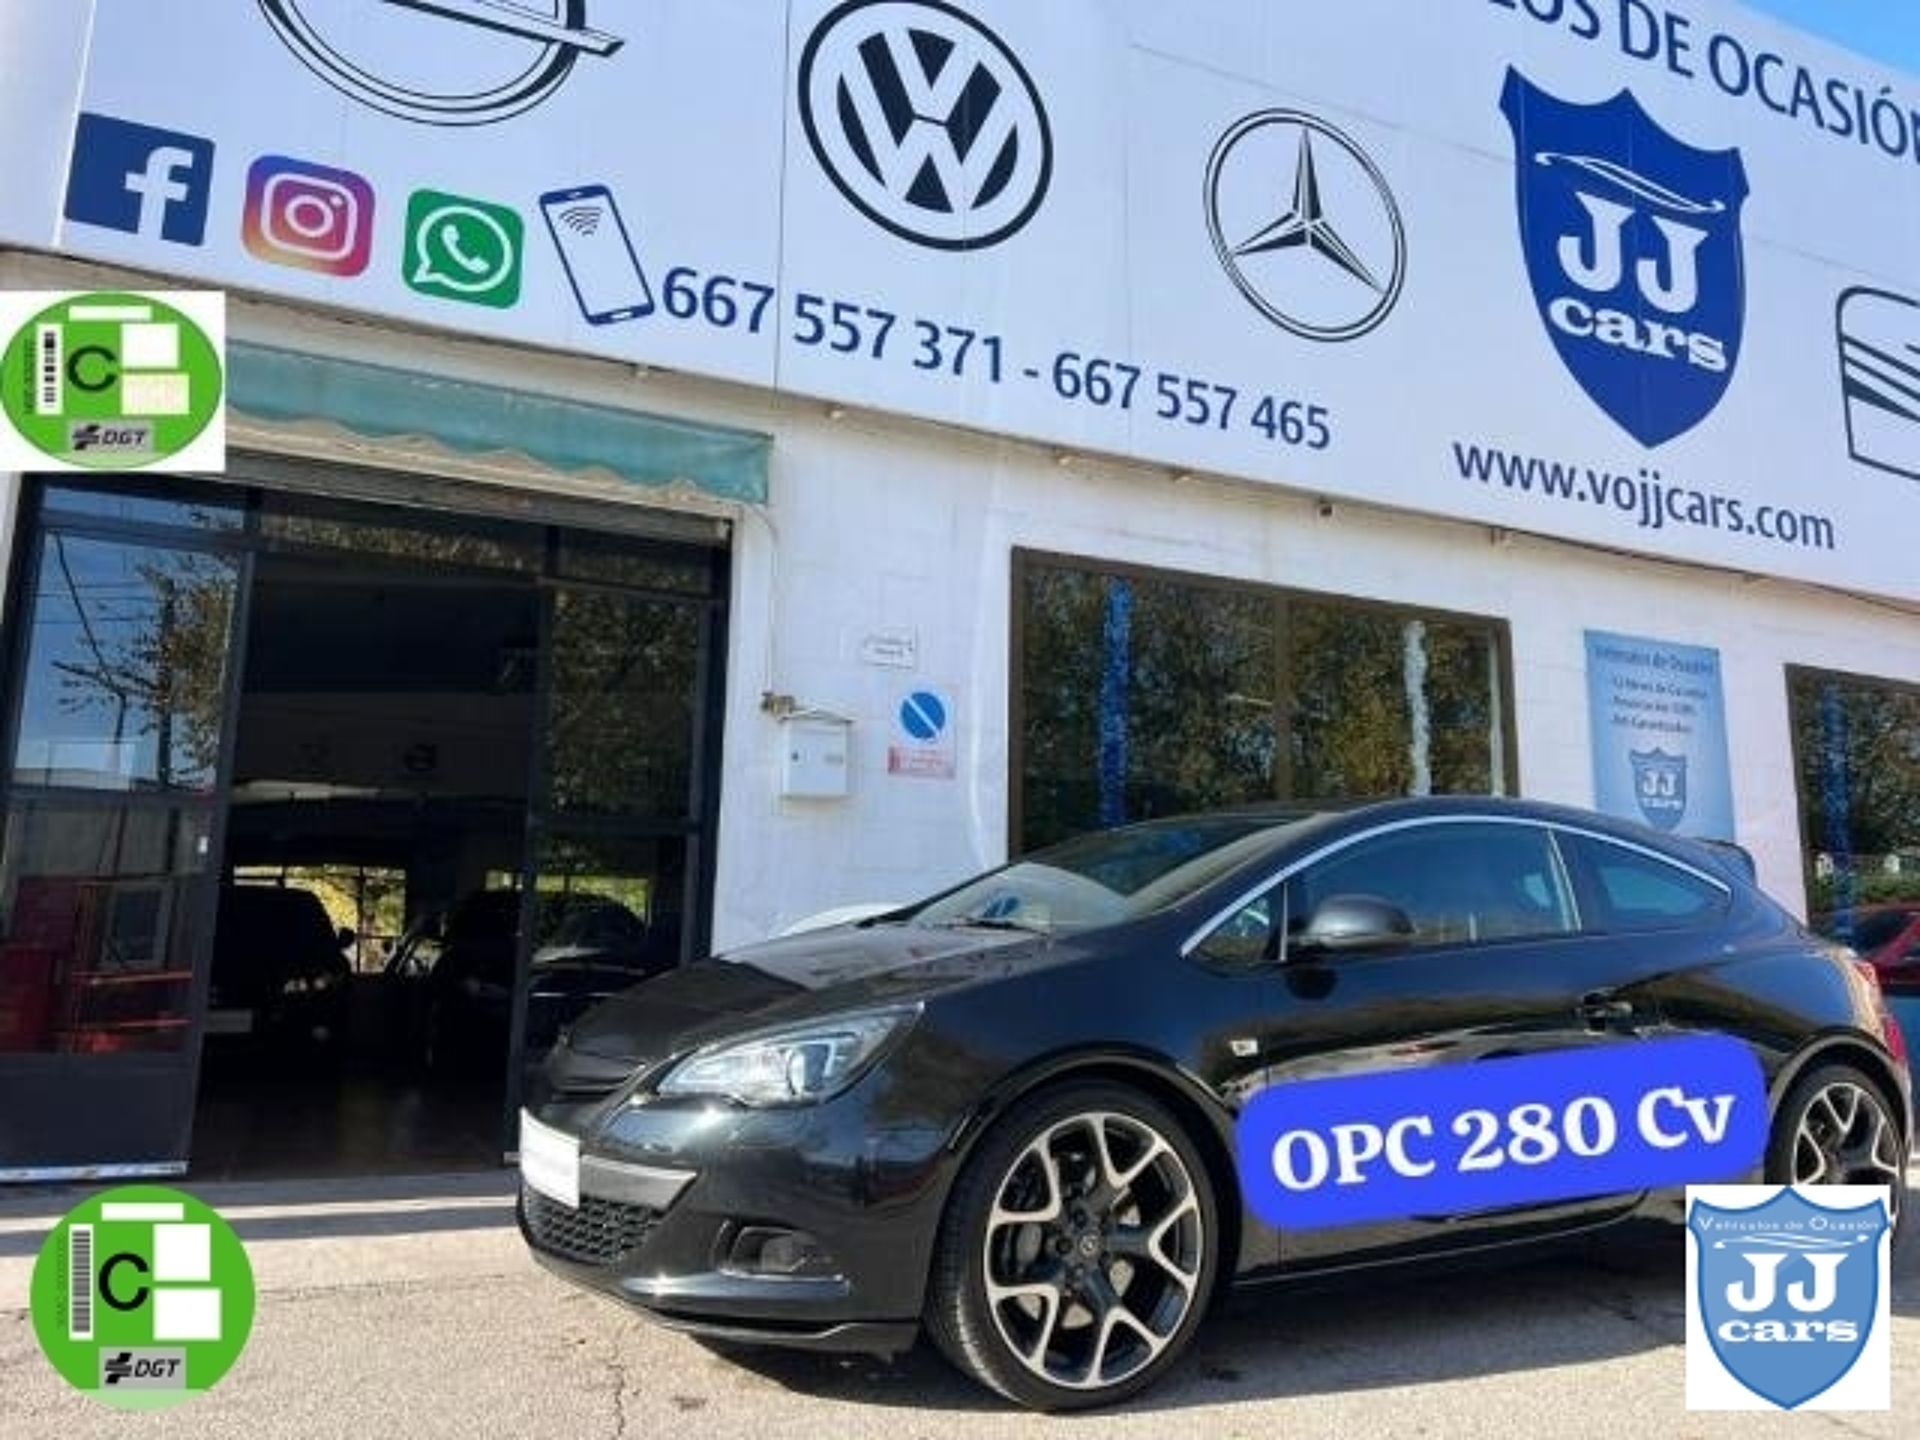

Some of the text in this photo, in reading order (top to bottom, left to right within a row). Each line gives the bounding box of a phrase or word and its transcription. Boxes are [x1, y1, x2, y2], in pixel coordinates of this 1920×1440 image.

[1620, 0, 1920, 165] DE OCASIÓ
[1557, 191, 1709, 313] JJ
[662, 266, 775, 333] 667
[792, 293, 897, 359] 557
[912, 318, 1001, 383] 371
[1052, 351, 1142, 410] 667
[1156, 373, 1238, 431] 557
[1250, 397, 1331, 450] 465
[1547, 297, 1728, 372] cars
[1453, 440, 1836, 549] www.vojjcars.com
